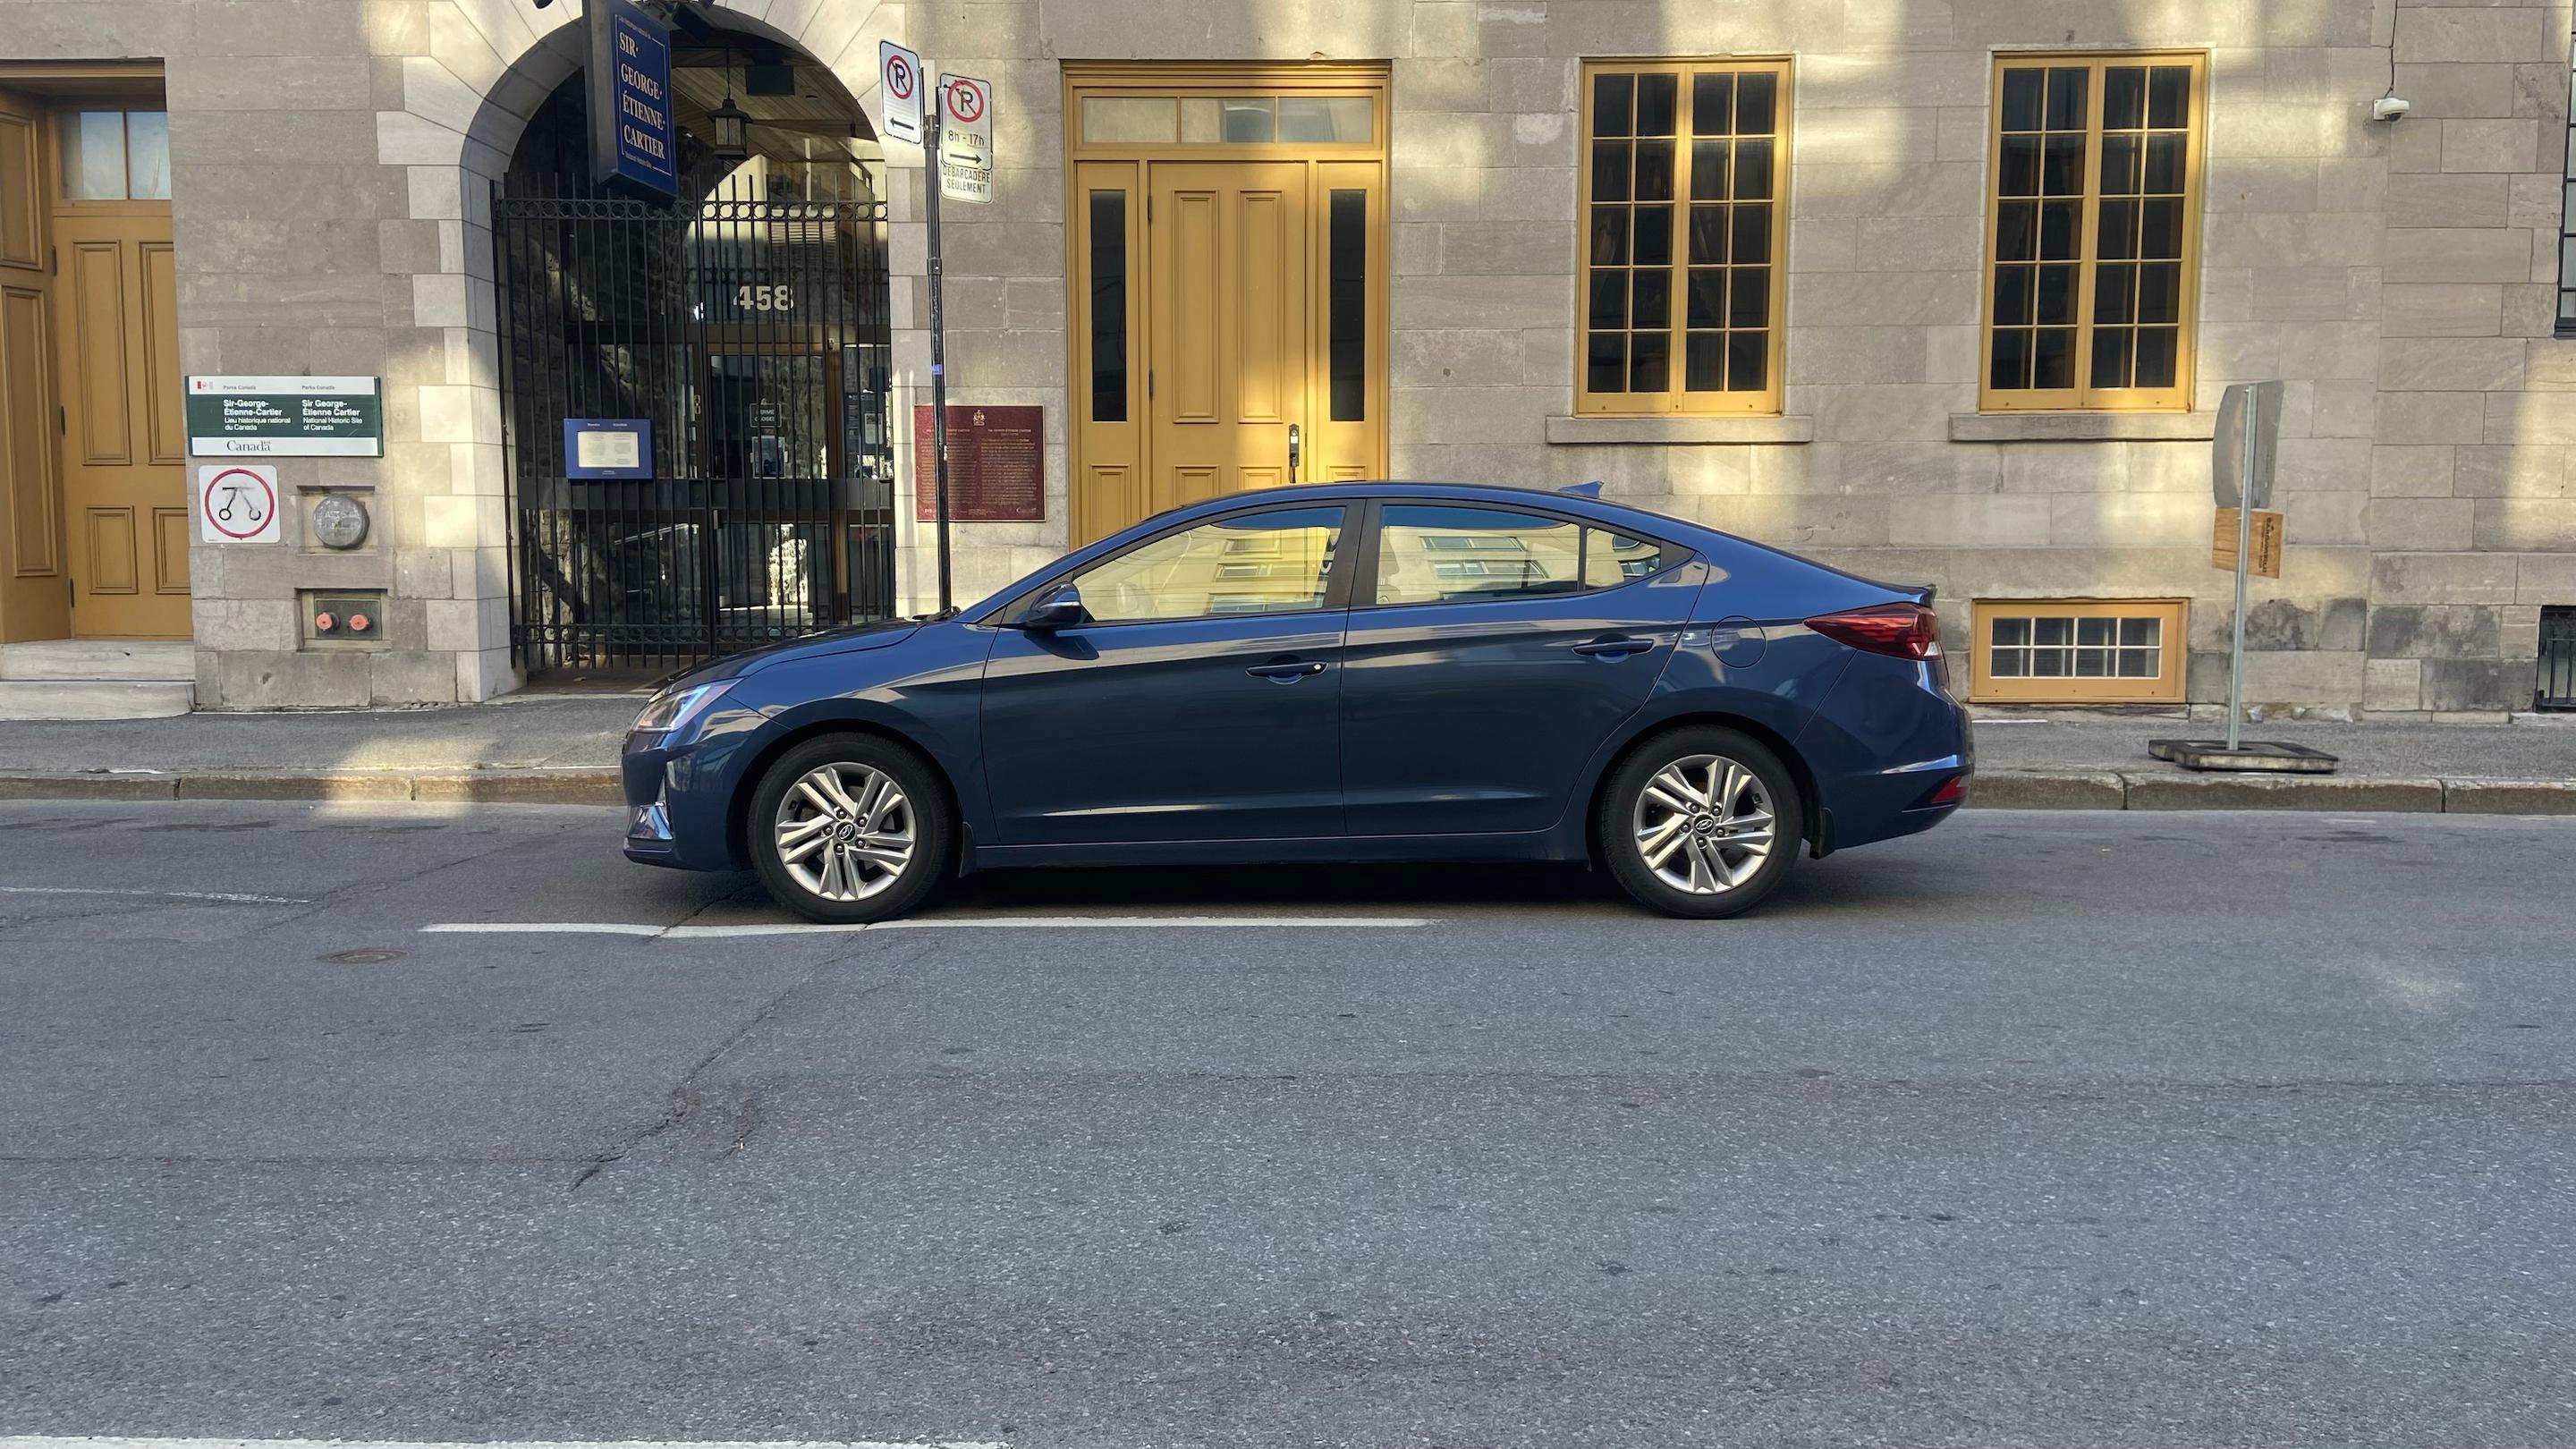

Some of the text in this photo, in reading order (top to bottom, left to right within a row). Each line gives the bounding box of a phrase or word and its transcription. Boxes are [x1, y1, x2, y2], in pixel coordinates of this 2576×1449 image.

[623, 124, 666, 160] CARTIER
[948, 130, 960, 142] 8h
[970, 132, 985, 146] 17h
[946, 178, 987, 194] SEULEMENT
[733, 284, 794, 311] 458
[223, 399, 269, 409] Sir-George-
[301, 399, 348, 409] Sir George-
[333, 408, 360, 416] Cartier
[238, 417, 267, 425] historique
[226, 439, 271, 452] Canada
